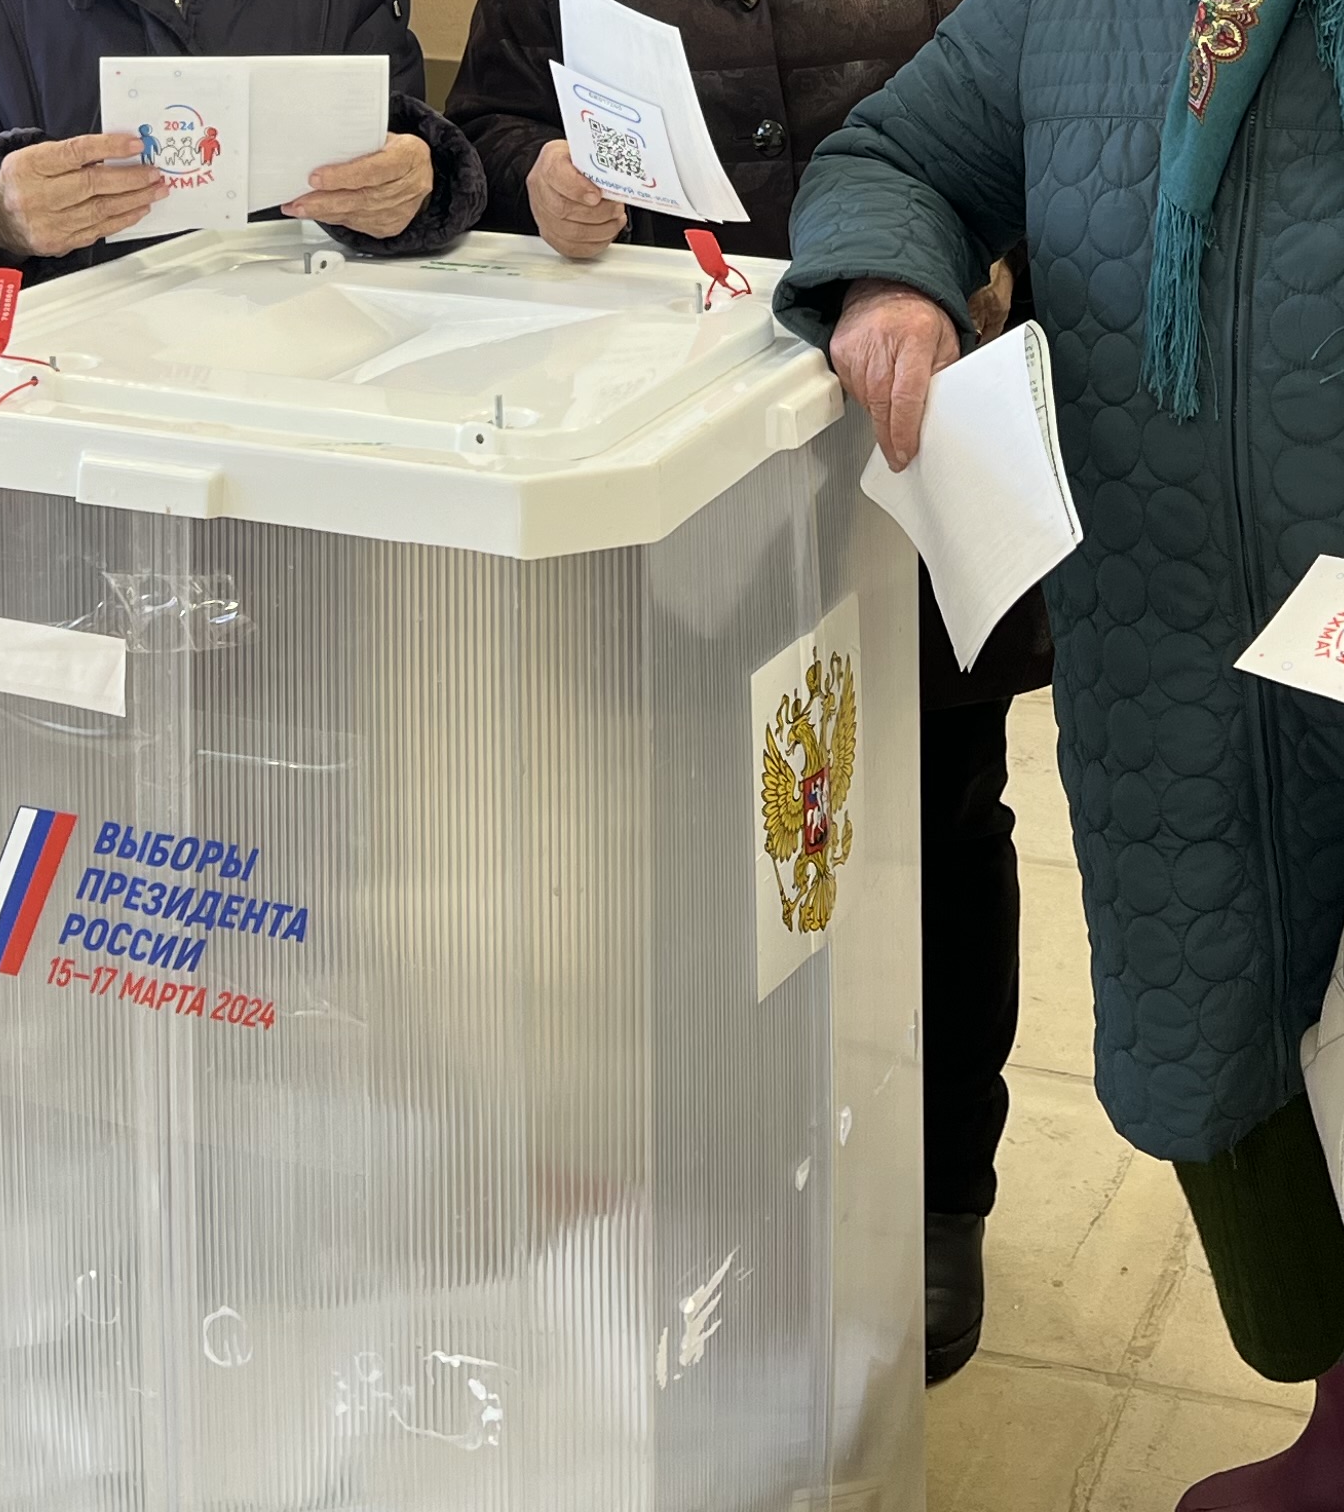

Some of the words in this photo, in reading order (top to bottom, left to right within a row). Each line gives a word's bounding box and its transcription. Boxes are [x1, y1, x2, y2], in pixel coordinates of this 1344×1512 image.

[164, 121, 195, 131] 2024
[93, 821, 259, 882] ВЫБОРЫ
[75, 867, 308, 943] ПРЕЗИДЕНТА
[58, 913, 206, 973] РОССИИ
[118, 971, 207, 1017] МАРТА
[210, 991, 275, 1030] 2024
